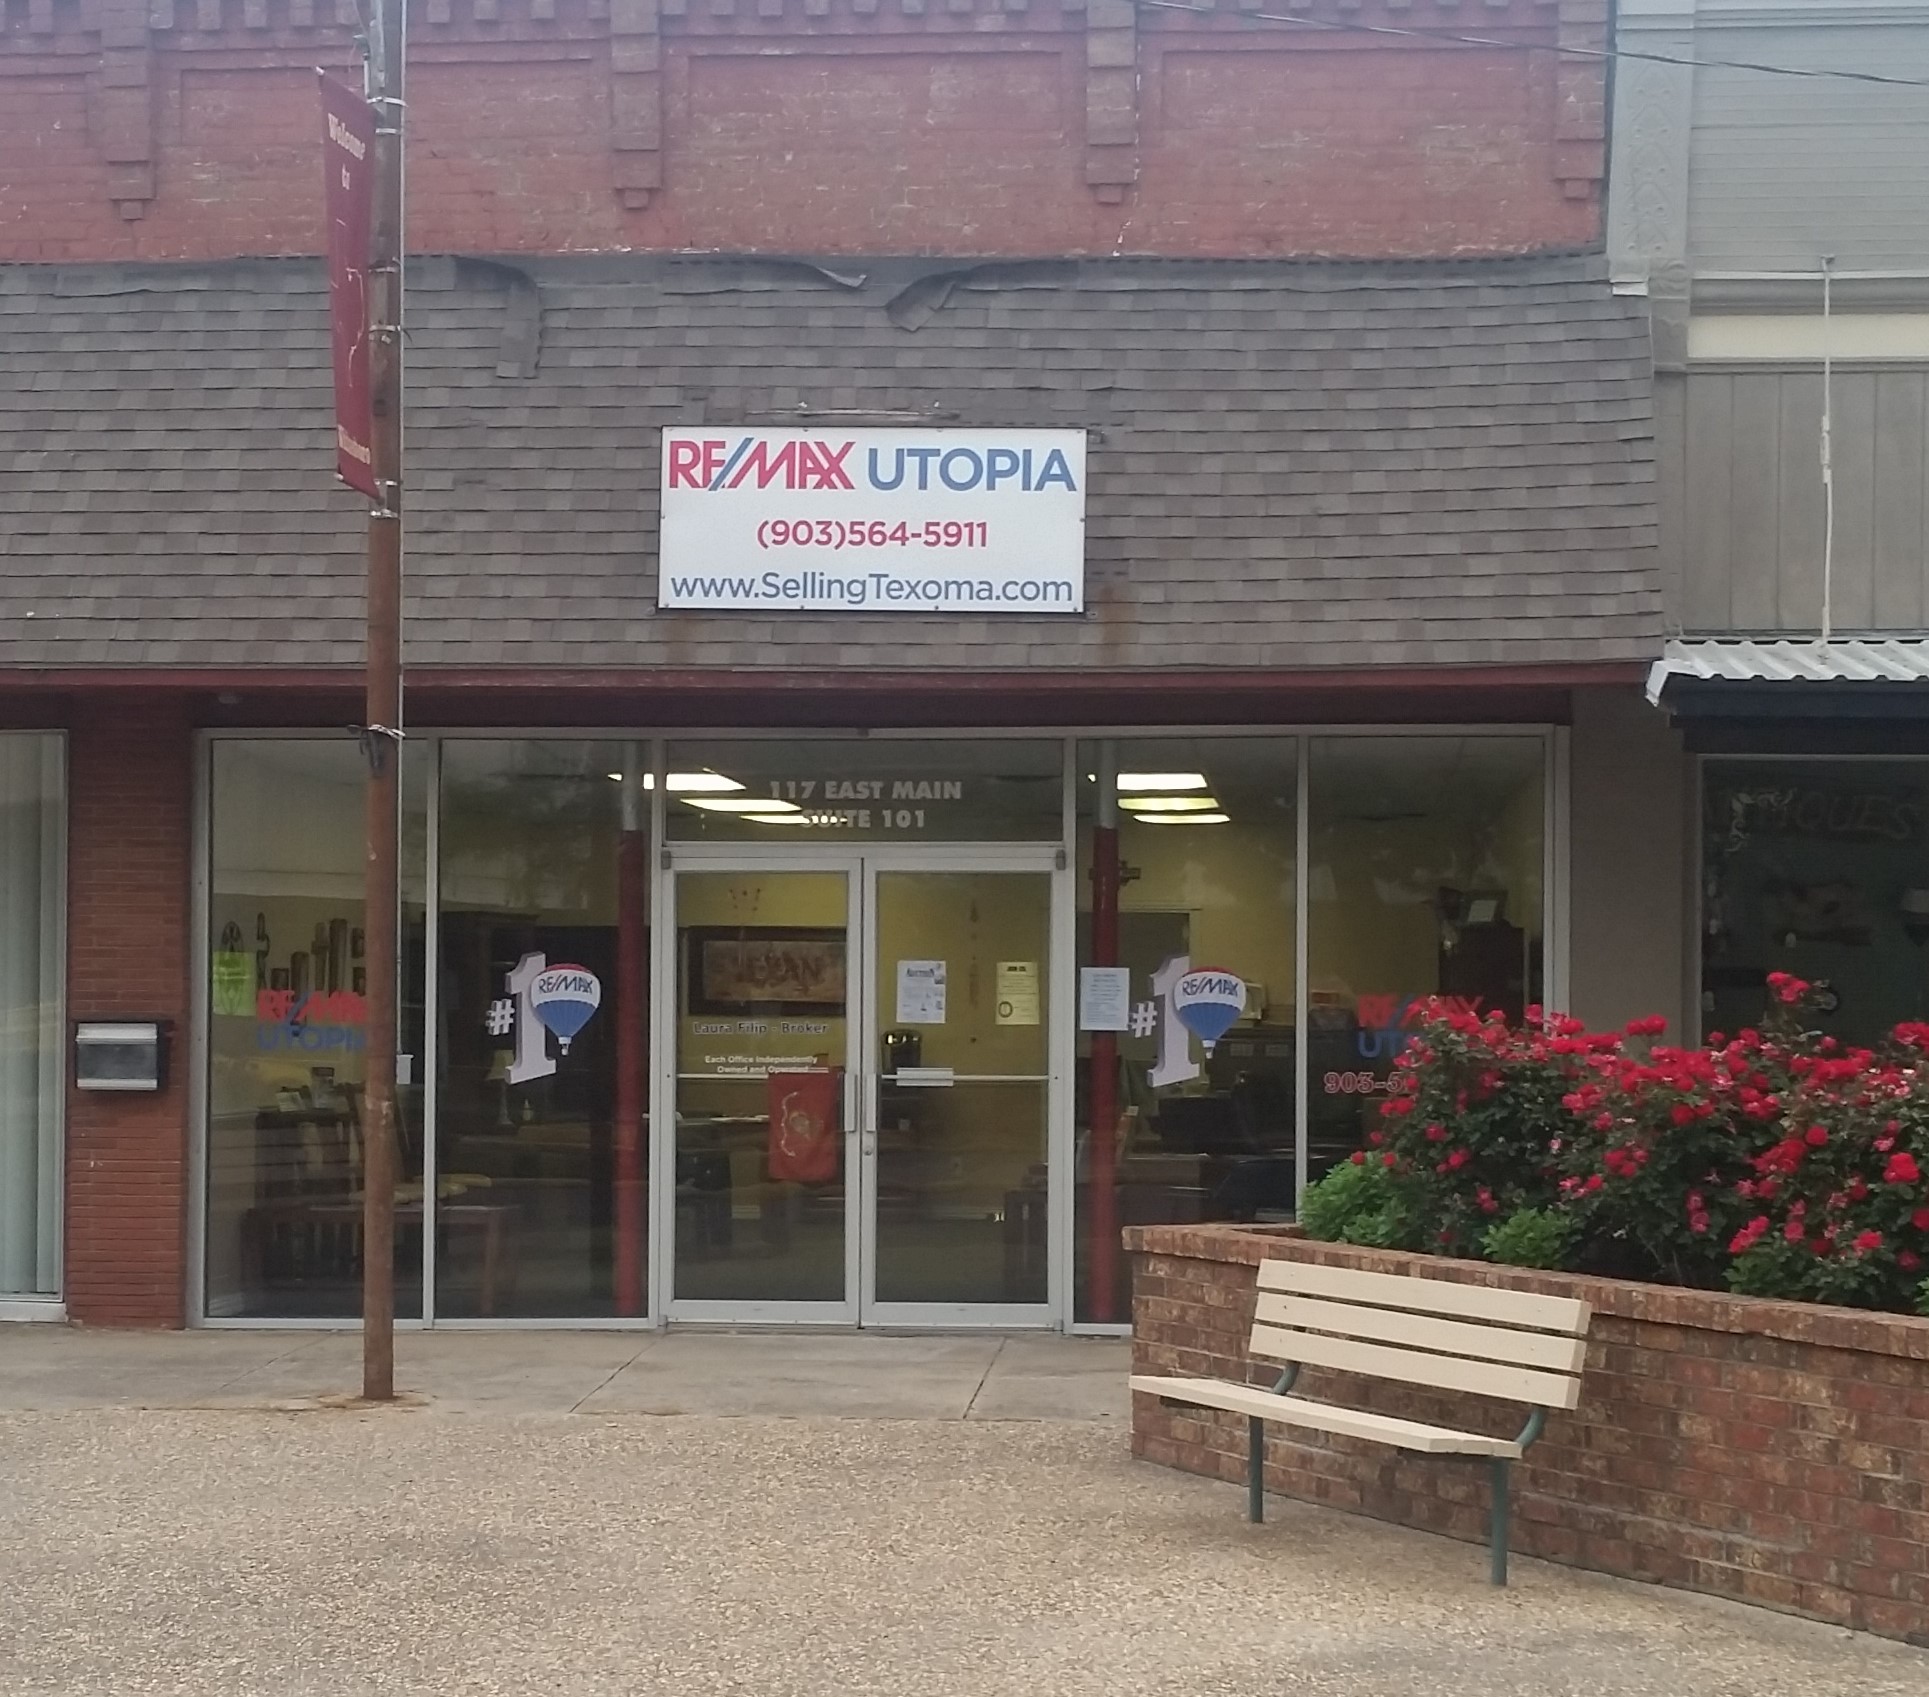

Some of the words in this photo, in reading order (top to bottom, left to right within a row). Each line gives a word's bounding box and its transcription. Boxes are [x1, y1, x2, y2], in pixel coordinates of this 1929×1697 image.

[669, 437, 855, 491] RE/MAX
[868, 447, 1077, 492] UTOPIA
[757, 519, 988, 550] (903)564-5911
[671, 572, 1073, 604] www.SellingTexoma.com
[770, 781, 816, 799] 117
[825, 781, 884, 799] EAST
[892, 781, 962, 799] MAIN
[801, 810, 871, 828] SUITE
[882, 810, 925, 828] 101
[538, 975, 593, 994] RE/MAX
[1182, 977, 1239, 996] RE/MAX
[694, 1022, 733, 1034] Laura
[737, 1022, 767, 1036] Filip
[781, 1022, 828, 1034] Broker
[705, 1055, 726, 1063] Each
[728, 1055, 754, 1063] Office
